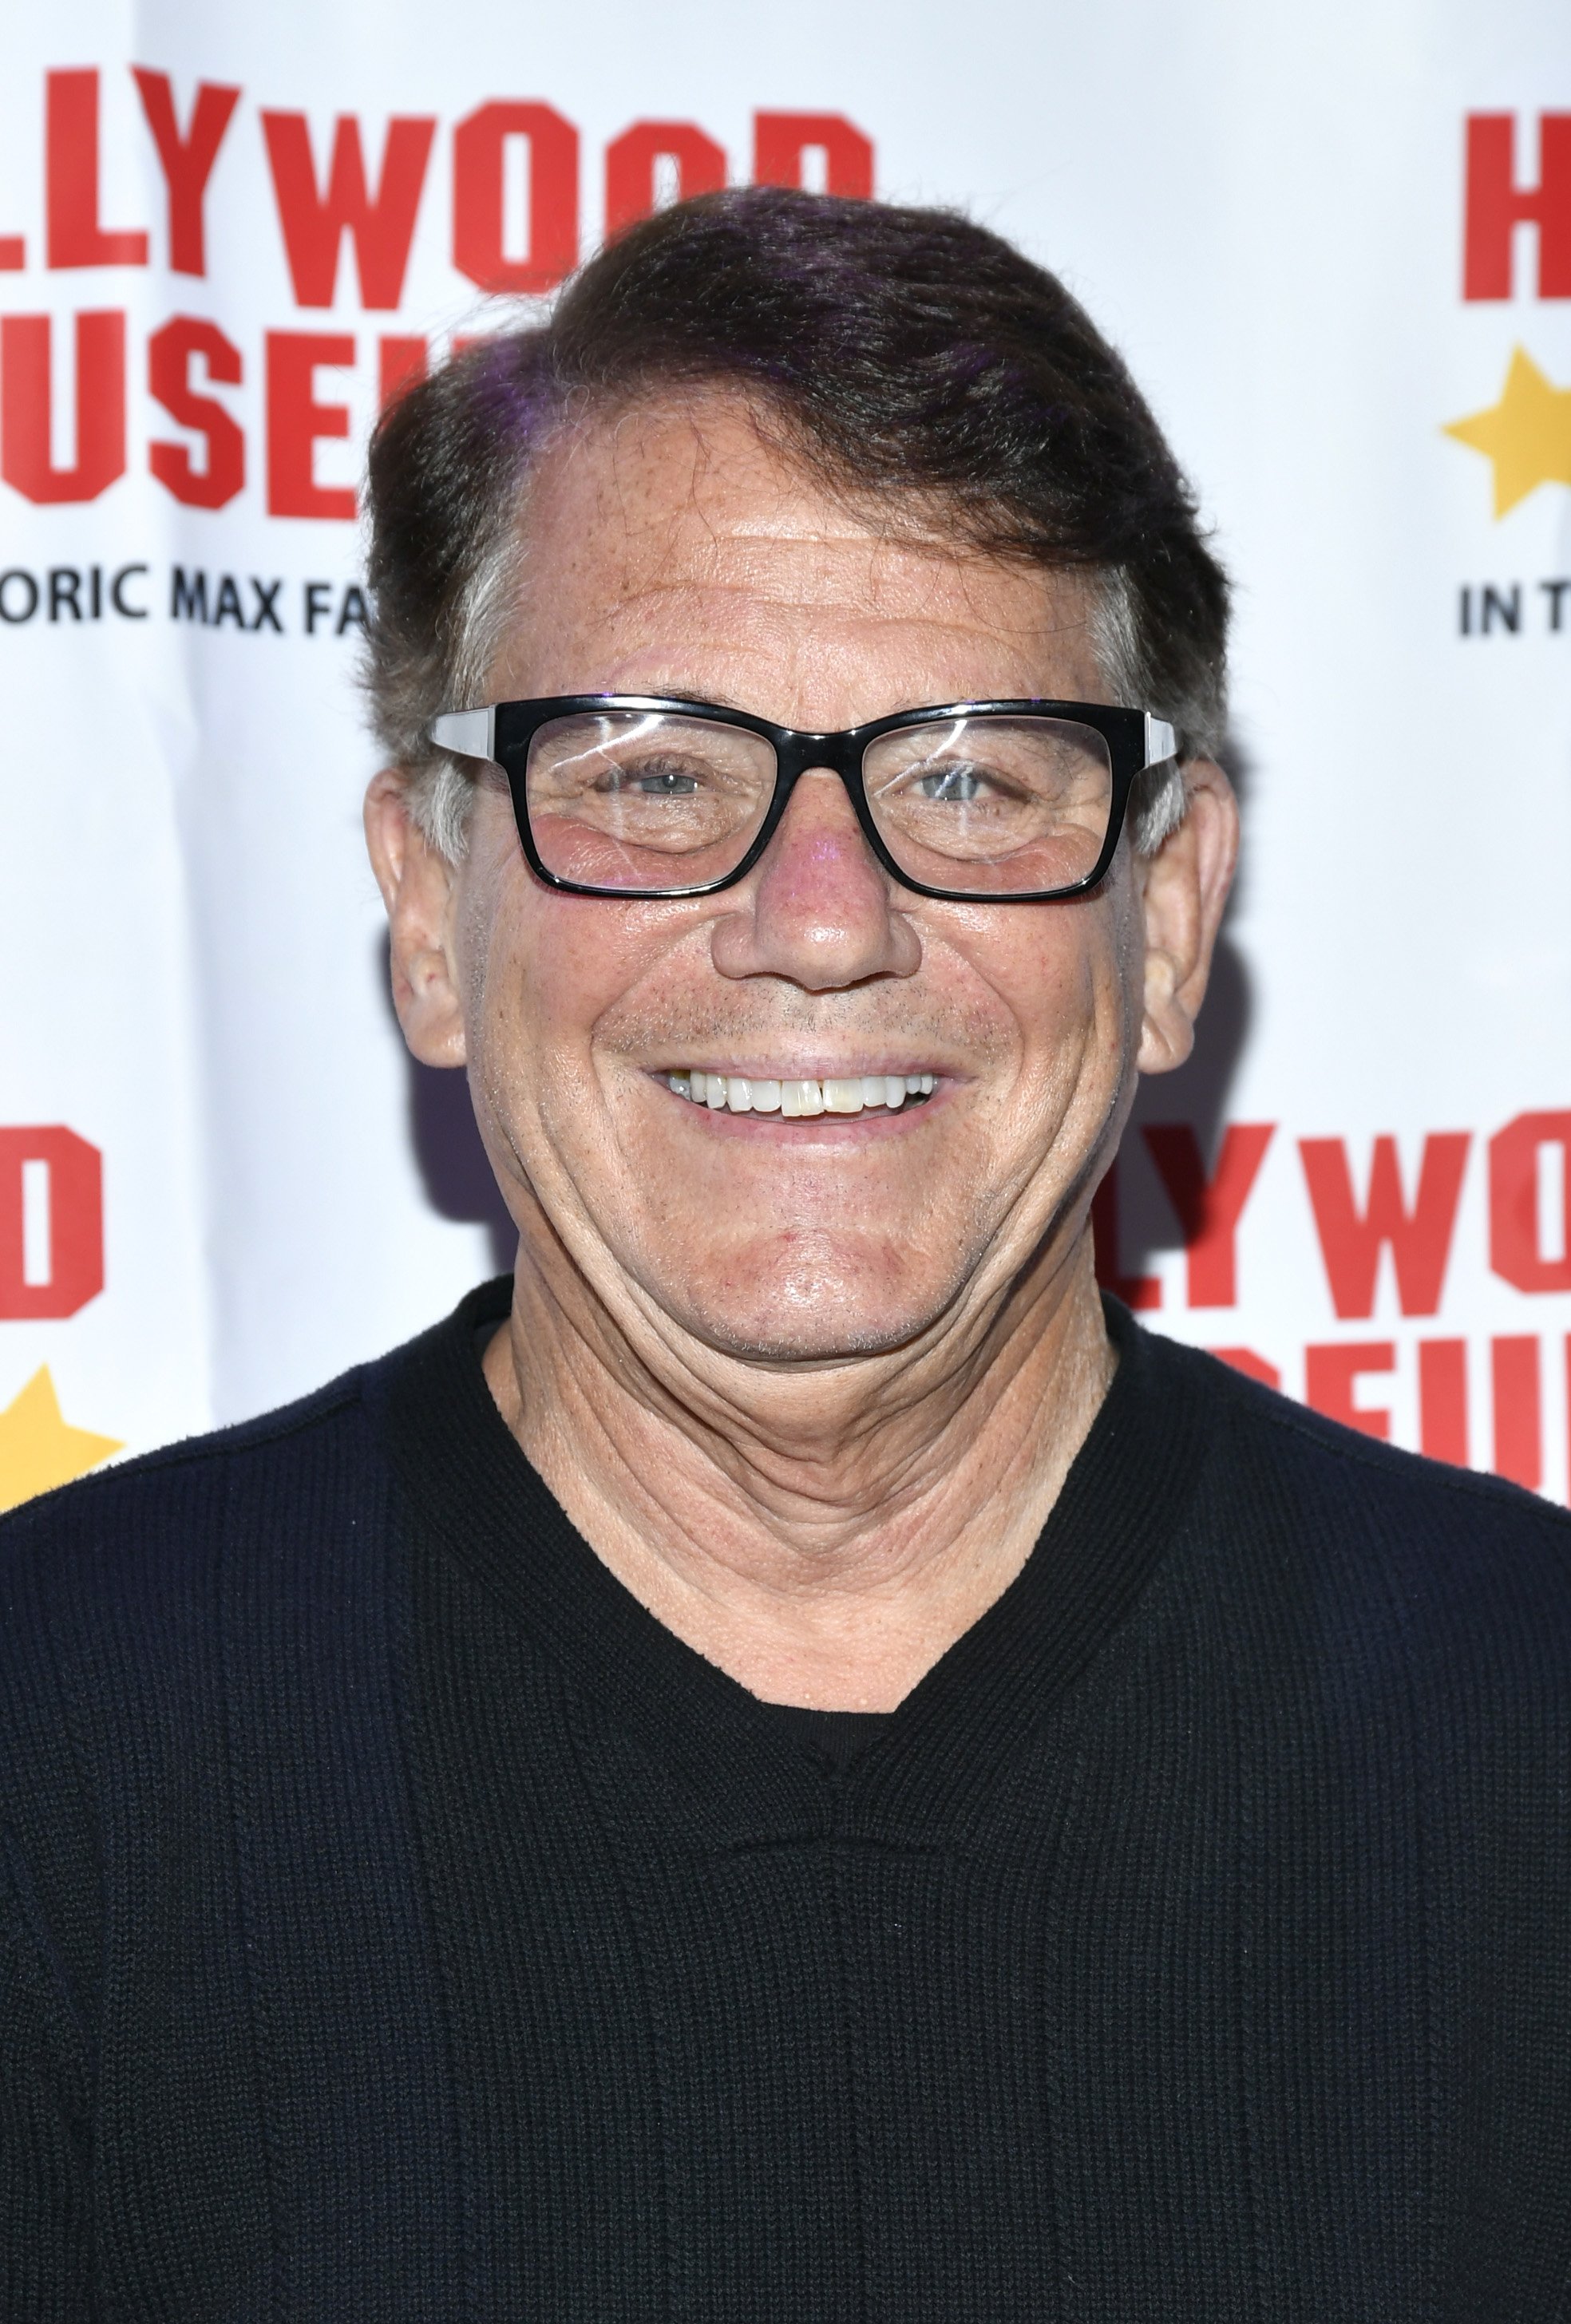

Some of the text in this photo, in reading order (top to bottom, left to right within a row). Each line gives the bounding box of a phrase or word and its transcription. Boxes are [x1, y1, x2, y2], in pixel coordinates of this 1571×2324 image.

[0, 63, 875, 310] LYWO
[0, 563, 150, 624] ORIC
[170, 563, 285, 636] MAX
[1458, 580, 1523, 637] IN
